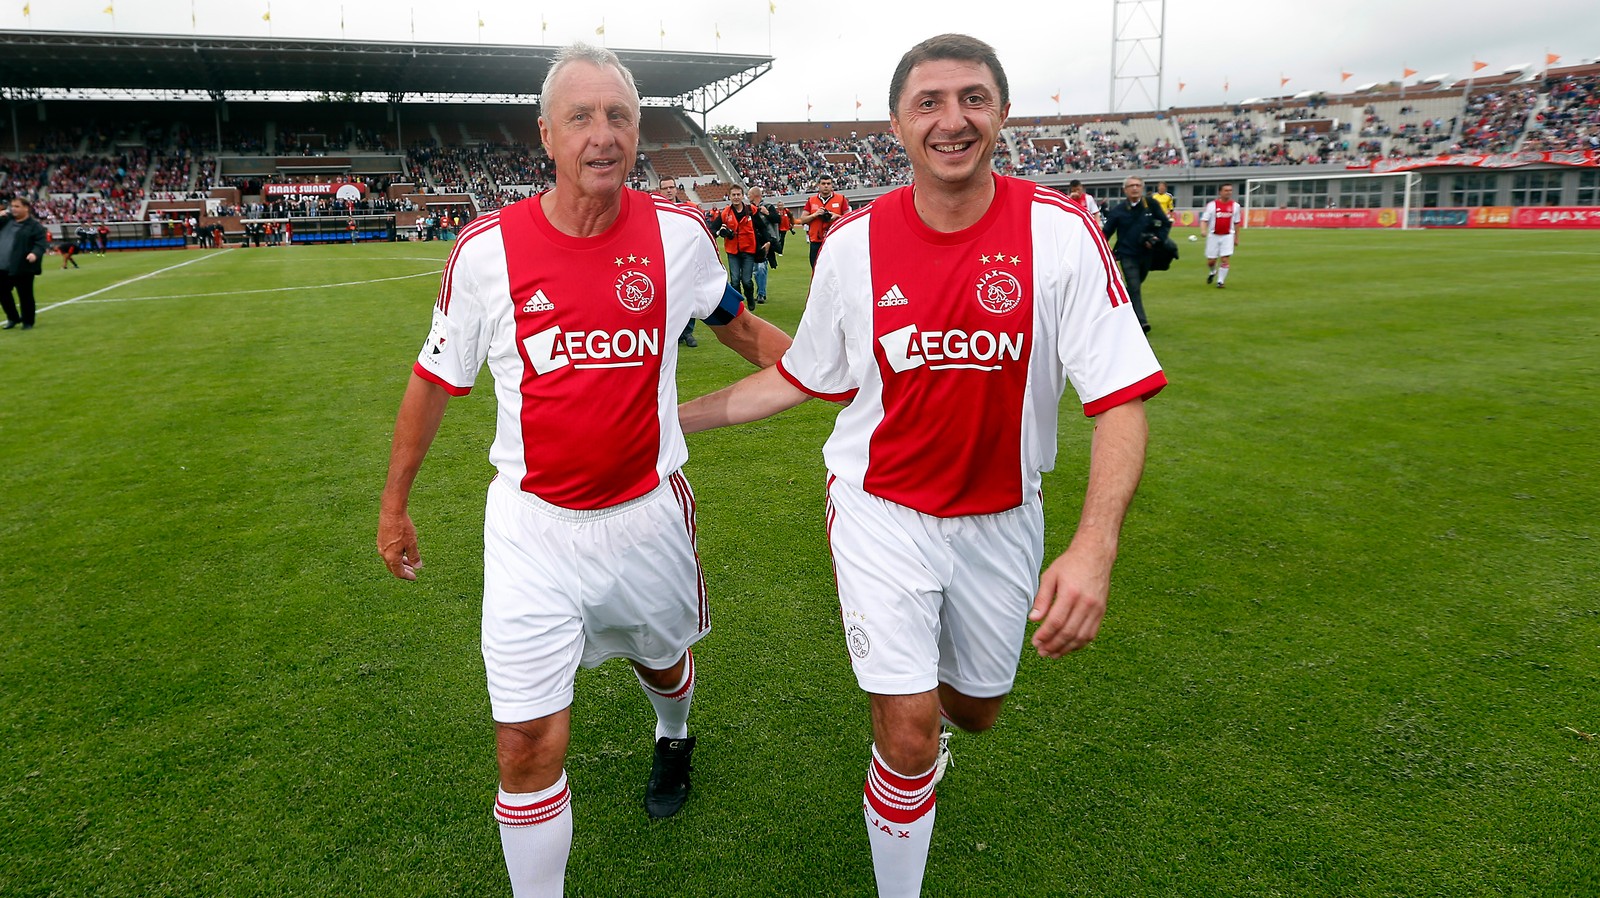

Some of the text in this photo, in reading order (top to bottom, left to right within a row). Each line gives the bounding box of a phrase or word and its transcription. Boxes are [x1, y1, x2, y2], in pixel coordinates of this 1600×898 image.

[268, 185, 331, 194] SJAAK SWART
[1284, 212, 1315, 222] AJAX
[1537, 210, 1588, 223] AJAX
[615, 271, 634, 290] AJAX
[976, 270, 999, 290] AJAX
[522, 303, 555, 313] adidas
[877, 298, 909, 307] adidas
[549, 327, 659, 360] AEGON
[905, 328, 1025, 361] AEGON
